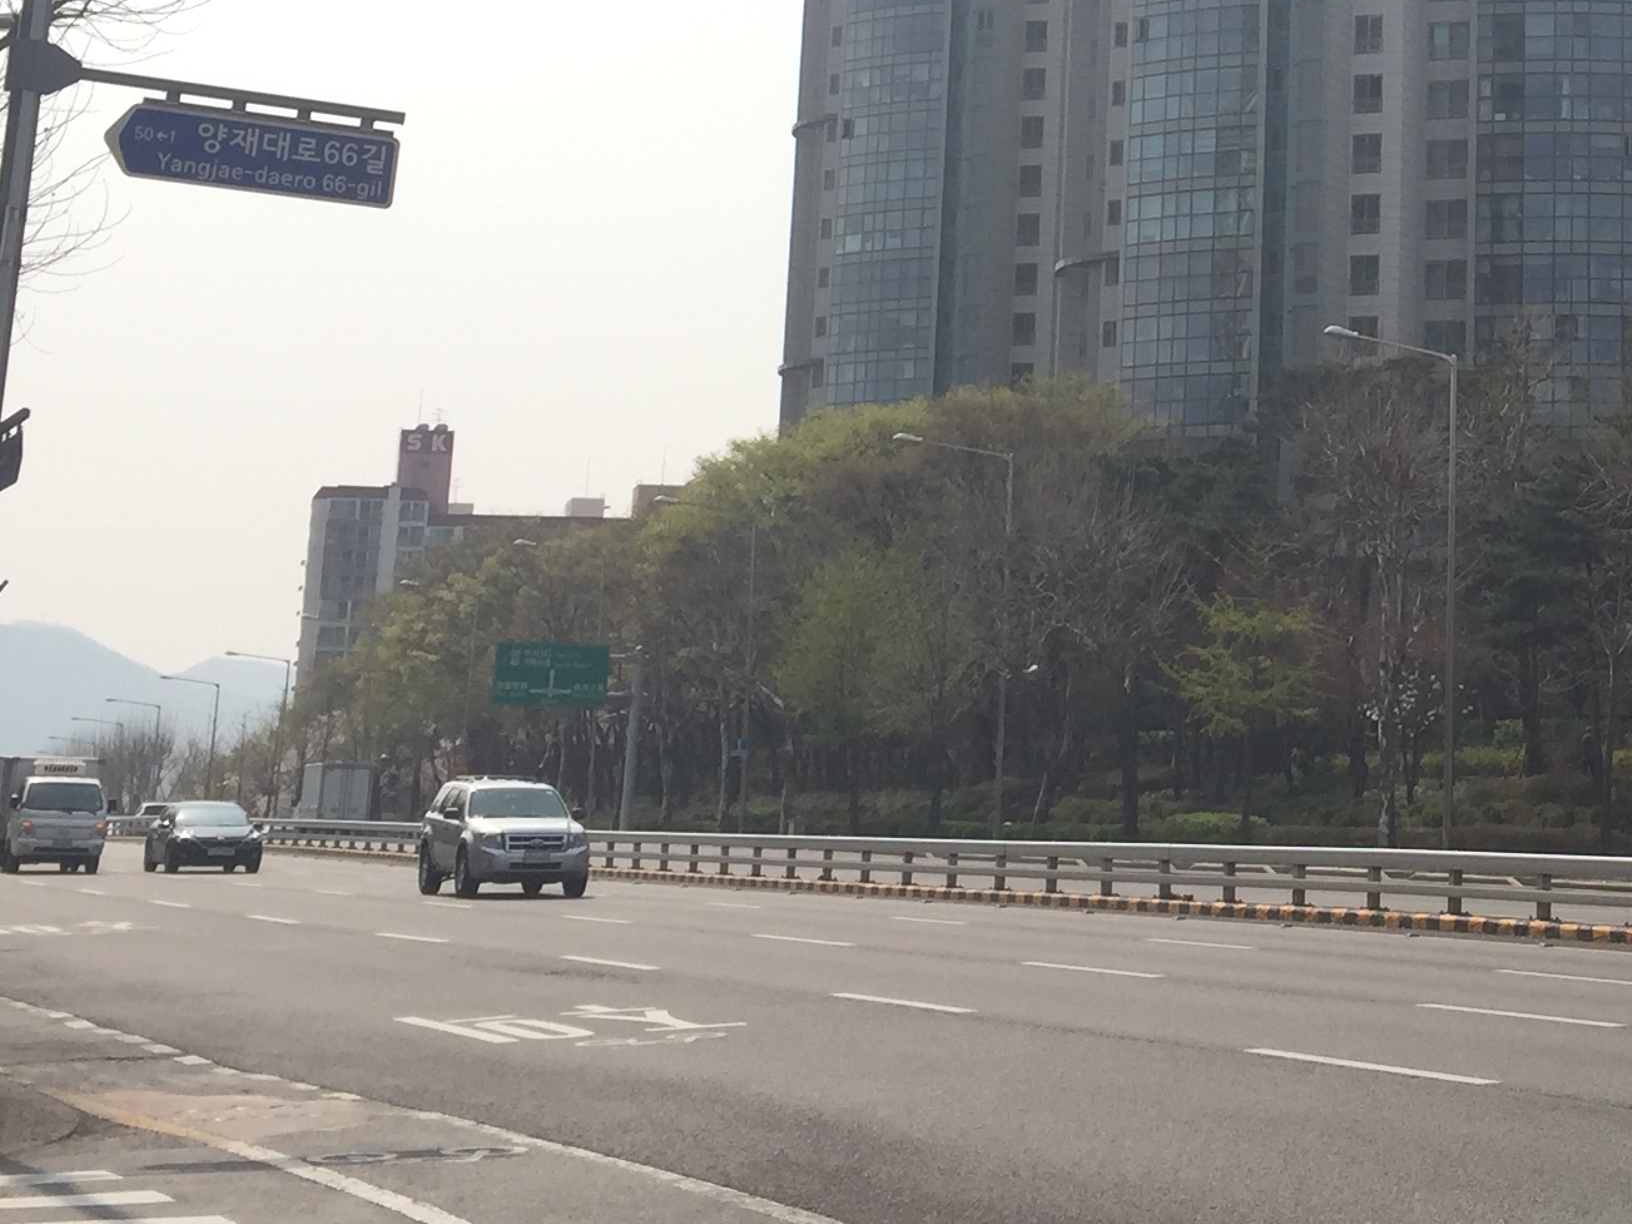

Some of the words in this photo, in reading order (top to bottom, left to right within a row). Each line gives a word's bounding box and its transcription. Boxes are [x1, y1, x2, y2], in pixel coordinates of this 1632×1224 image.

[197, 123, 387, 175] 양재대로66길
[157, 152, 317, 190] Yangjae-daero
[321, 174, 383, 200] 66-gil
